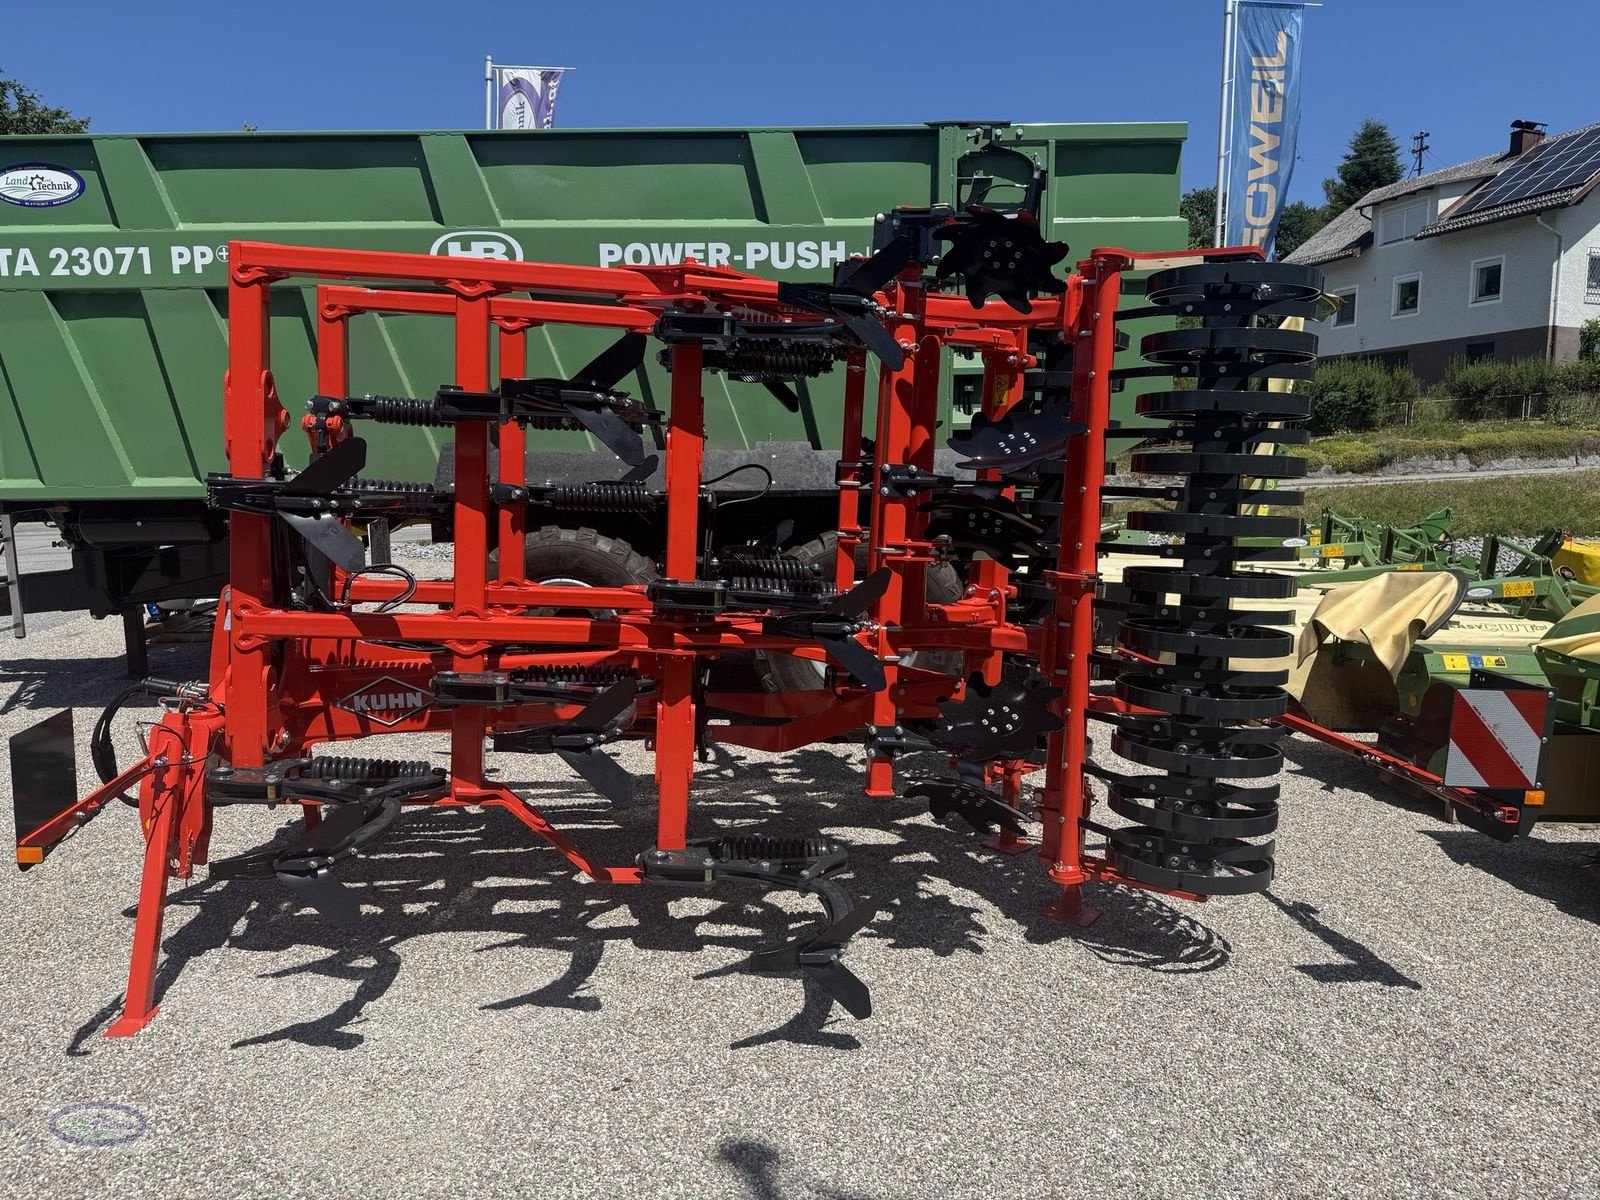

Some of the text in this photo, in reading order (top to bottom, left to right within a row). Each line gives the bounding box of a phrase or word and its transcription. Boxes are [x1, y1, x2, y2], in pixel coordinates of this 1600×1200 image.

[5, 176, 29, 186] Land
[36, 180, 73, 190] Technik
[49, 247, 152, 276] 23071
[599, 240, 846, 269] POWER-PUSH
[353, 692, 423, 710] KUHN
